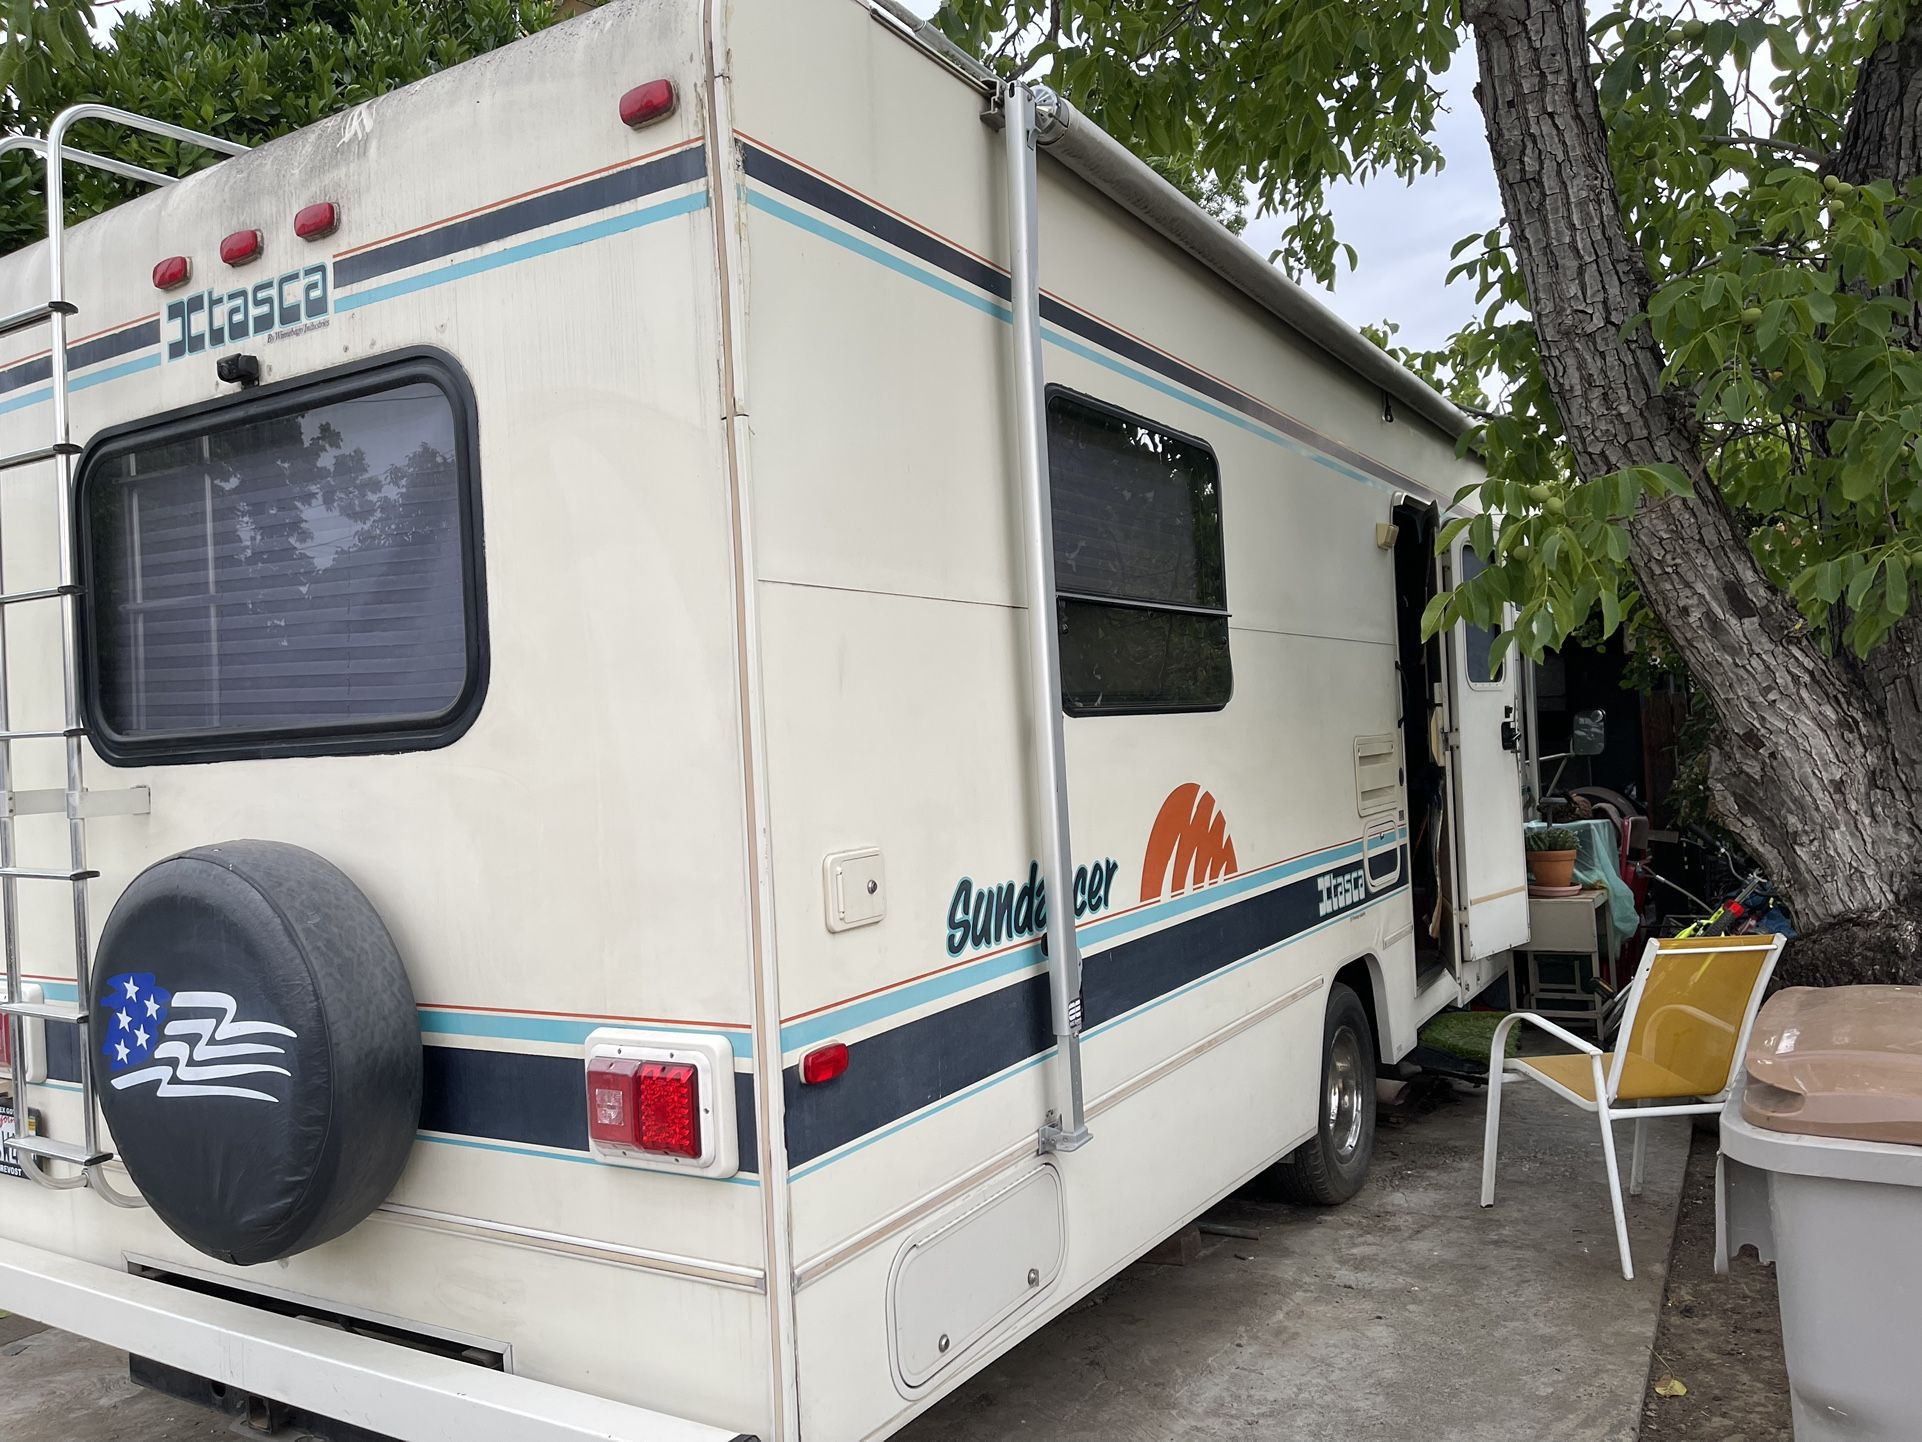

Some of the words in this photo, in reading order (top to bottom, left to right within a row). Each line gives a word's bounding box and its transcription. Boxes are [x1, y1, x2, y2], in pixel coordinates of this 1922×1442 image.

[167, 262, 329, 362] Itasca
[946, 857, 1119, 957] Sundacer
[1317, 868, 1366, 917] Itasca
